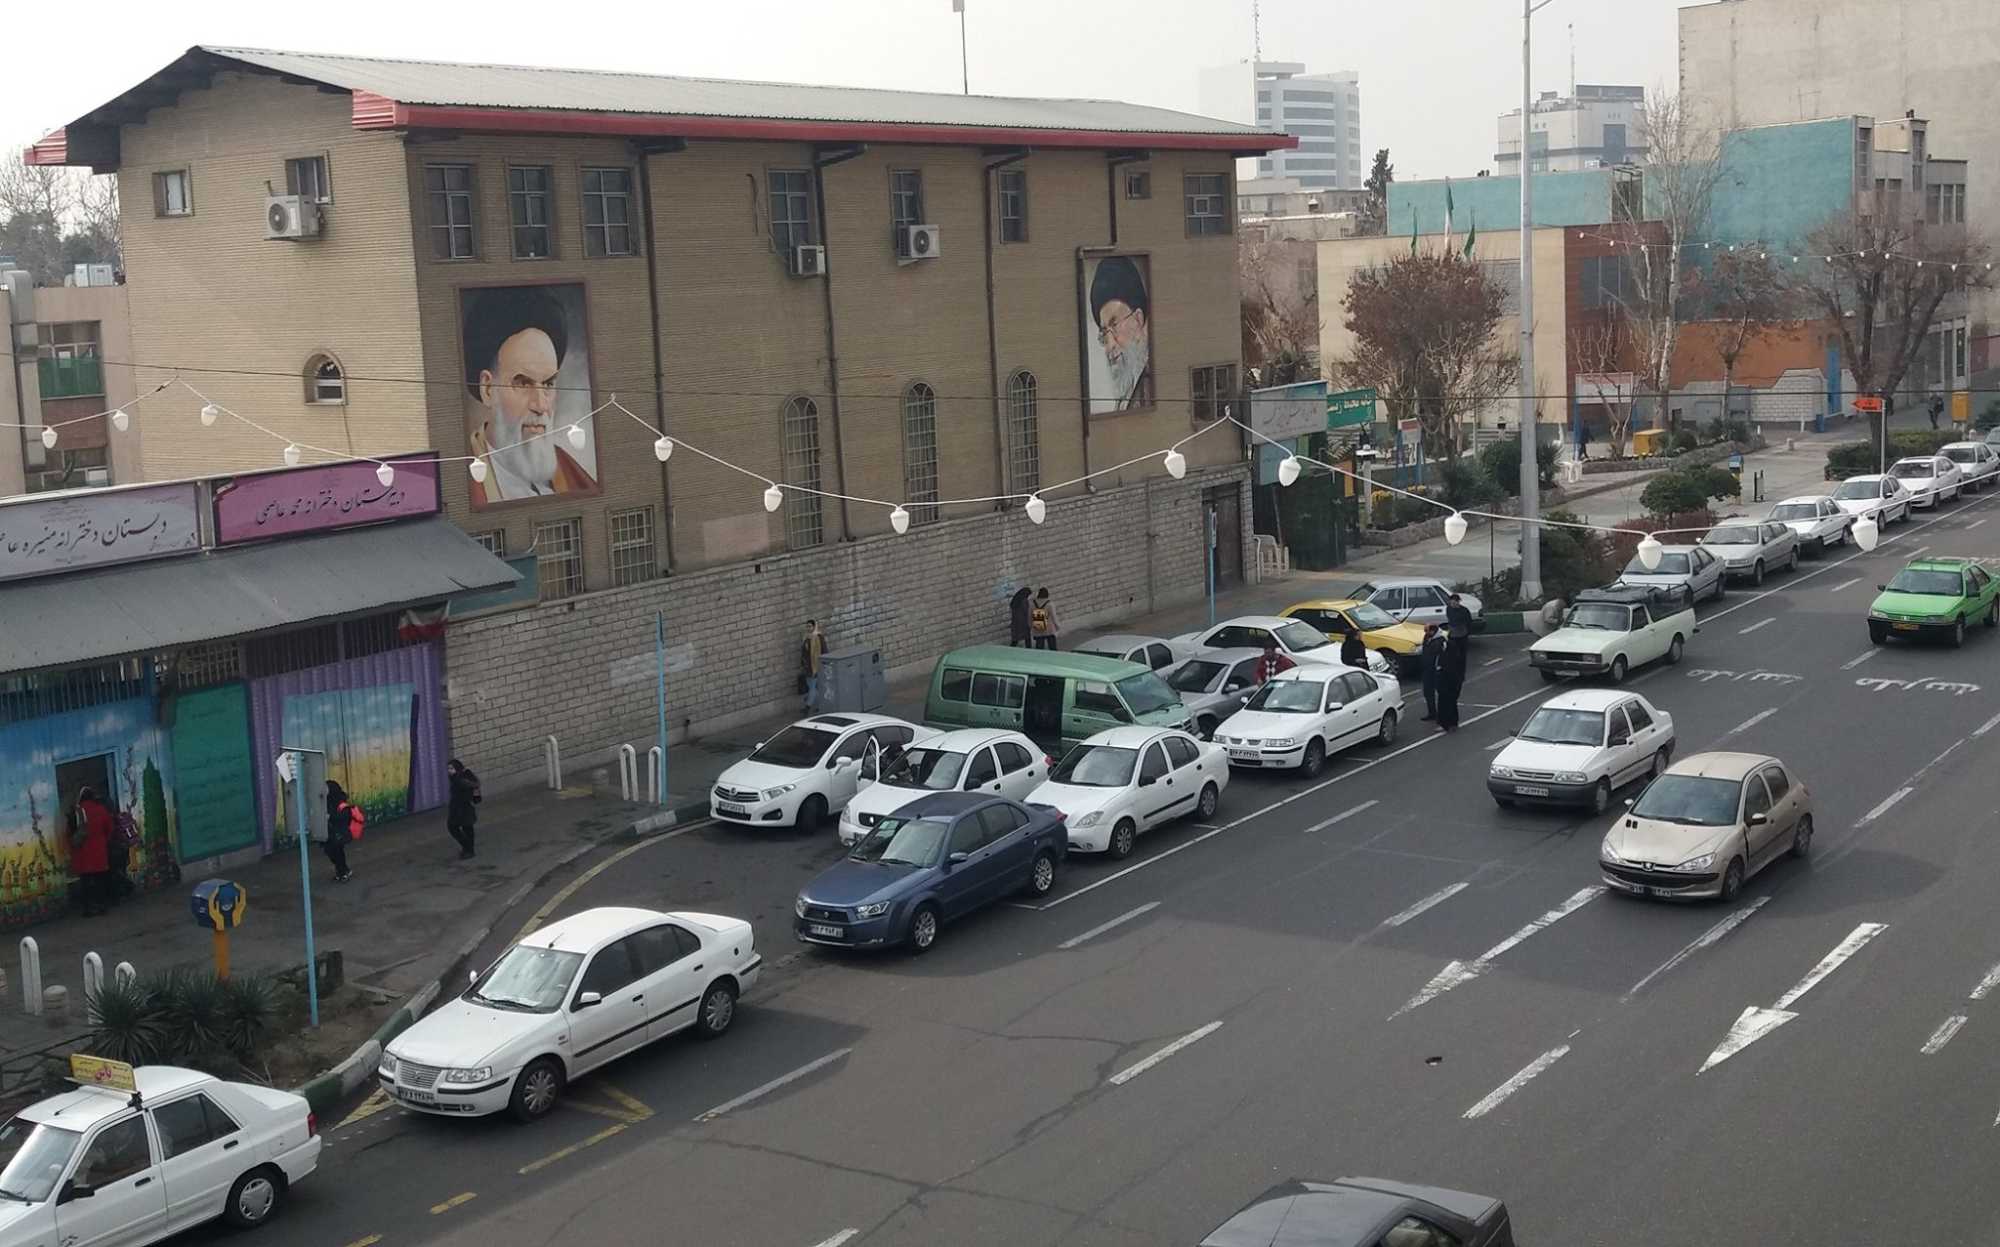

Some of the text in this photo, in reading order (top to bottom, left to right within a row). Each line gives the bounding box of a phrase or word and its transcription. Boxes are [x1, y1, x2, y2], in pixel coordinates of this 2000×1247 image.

[305, 490, 339, 514] دخترانه
[341, 486, 405, 513] دبیرستان
[22, 526, 56, 557] منیره
[56, 520, 98, 552] دخترانه
[101, 512, 168, 547] دبستان
